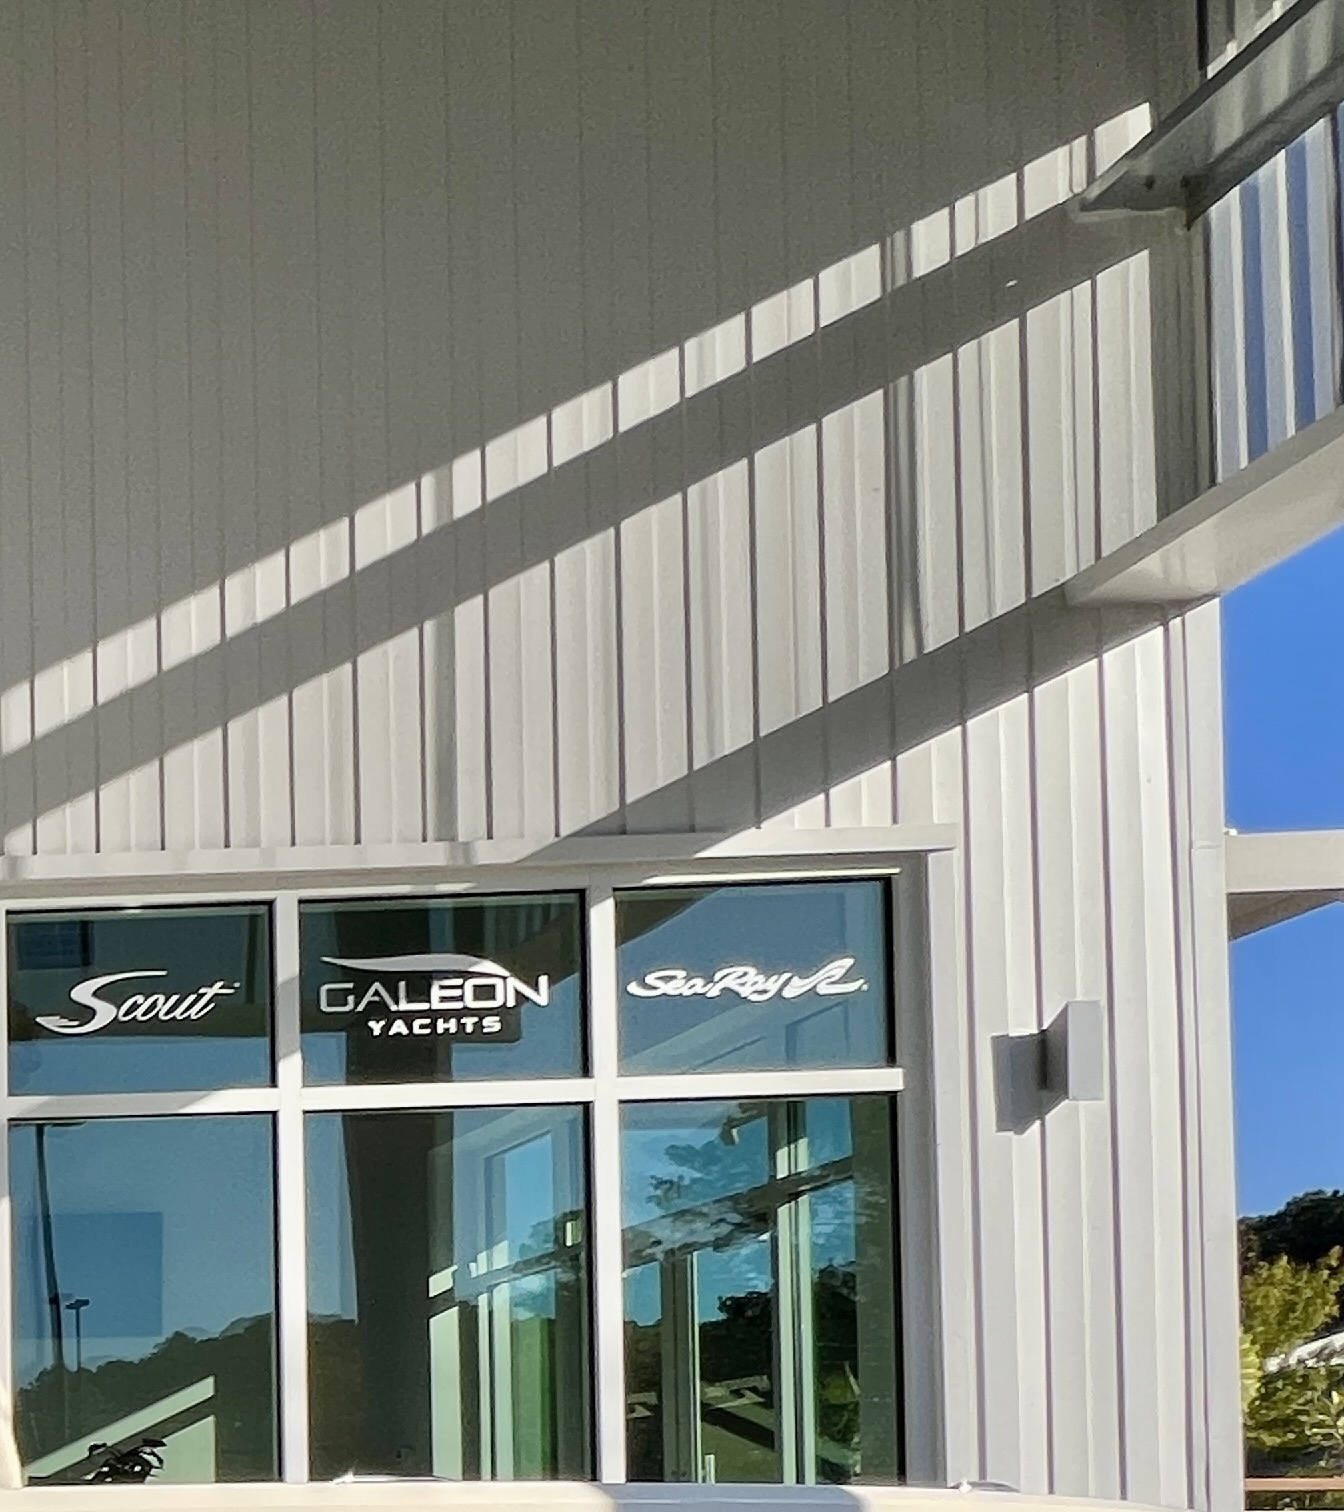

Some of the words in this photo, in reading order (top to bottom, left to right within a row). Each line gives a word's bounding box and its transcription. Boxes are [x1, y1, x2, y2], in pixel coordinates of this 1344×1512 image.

[34, 970, 238, 1034] Scout
[318, 974, 550, 1013] GALEON
[367, 1016, 502, 1036] YACHTS
